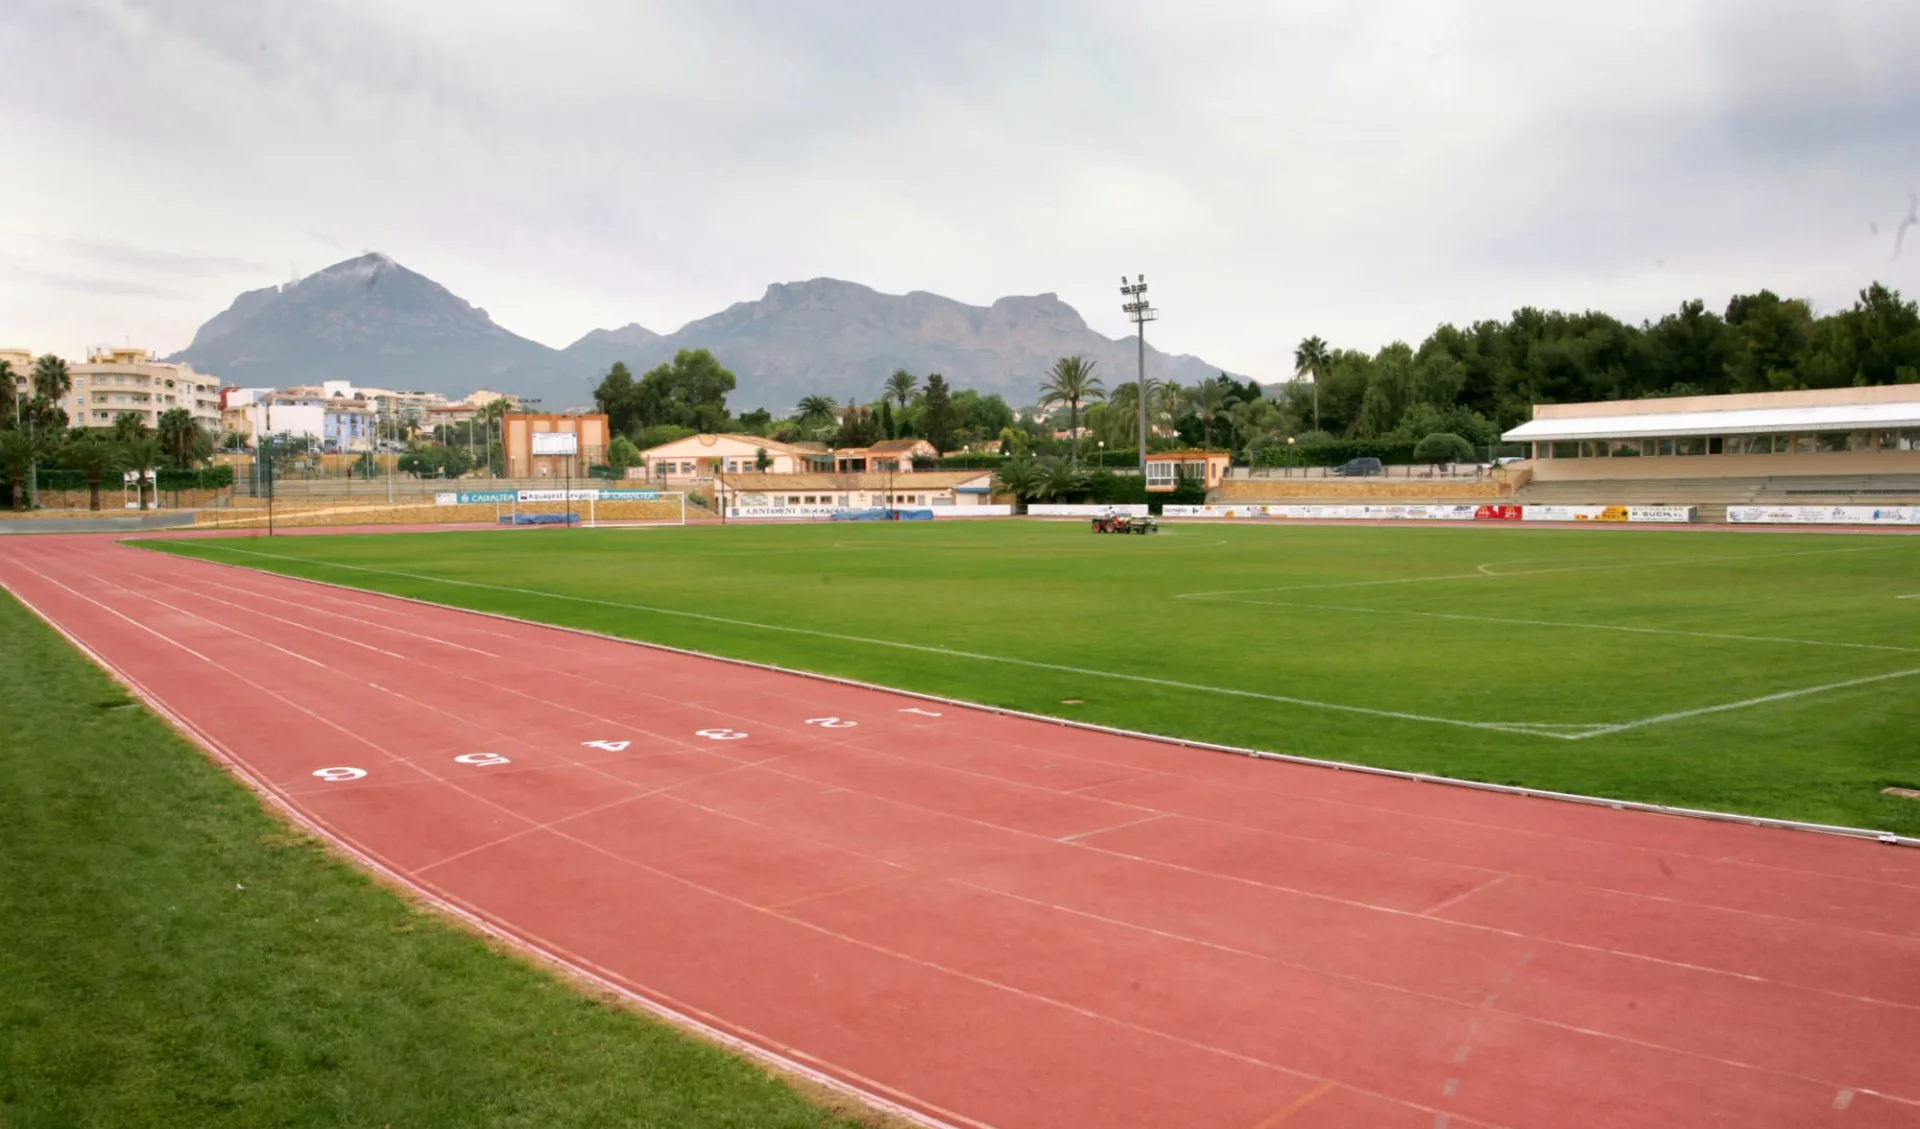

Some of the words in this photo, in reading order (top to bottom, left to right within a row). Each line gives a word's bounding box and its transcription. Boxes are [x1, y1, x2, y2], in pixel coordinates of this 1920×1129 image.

[472, 493, 515, 502] CAIXALTEA
[898, 707, 942, 717] 1
[804, 716, 858, 728] 2
[695, 728, 749, 740] 3
[580, 739, 631, 752] 4
[454, 752, 511, 767] 5
[312, 766, 368, 781] 6
